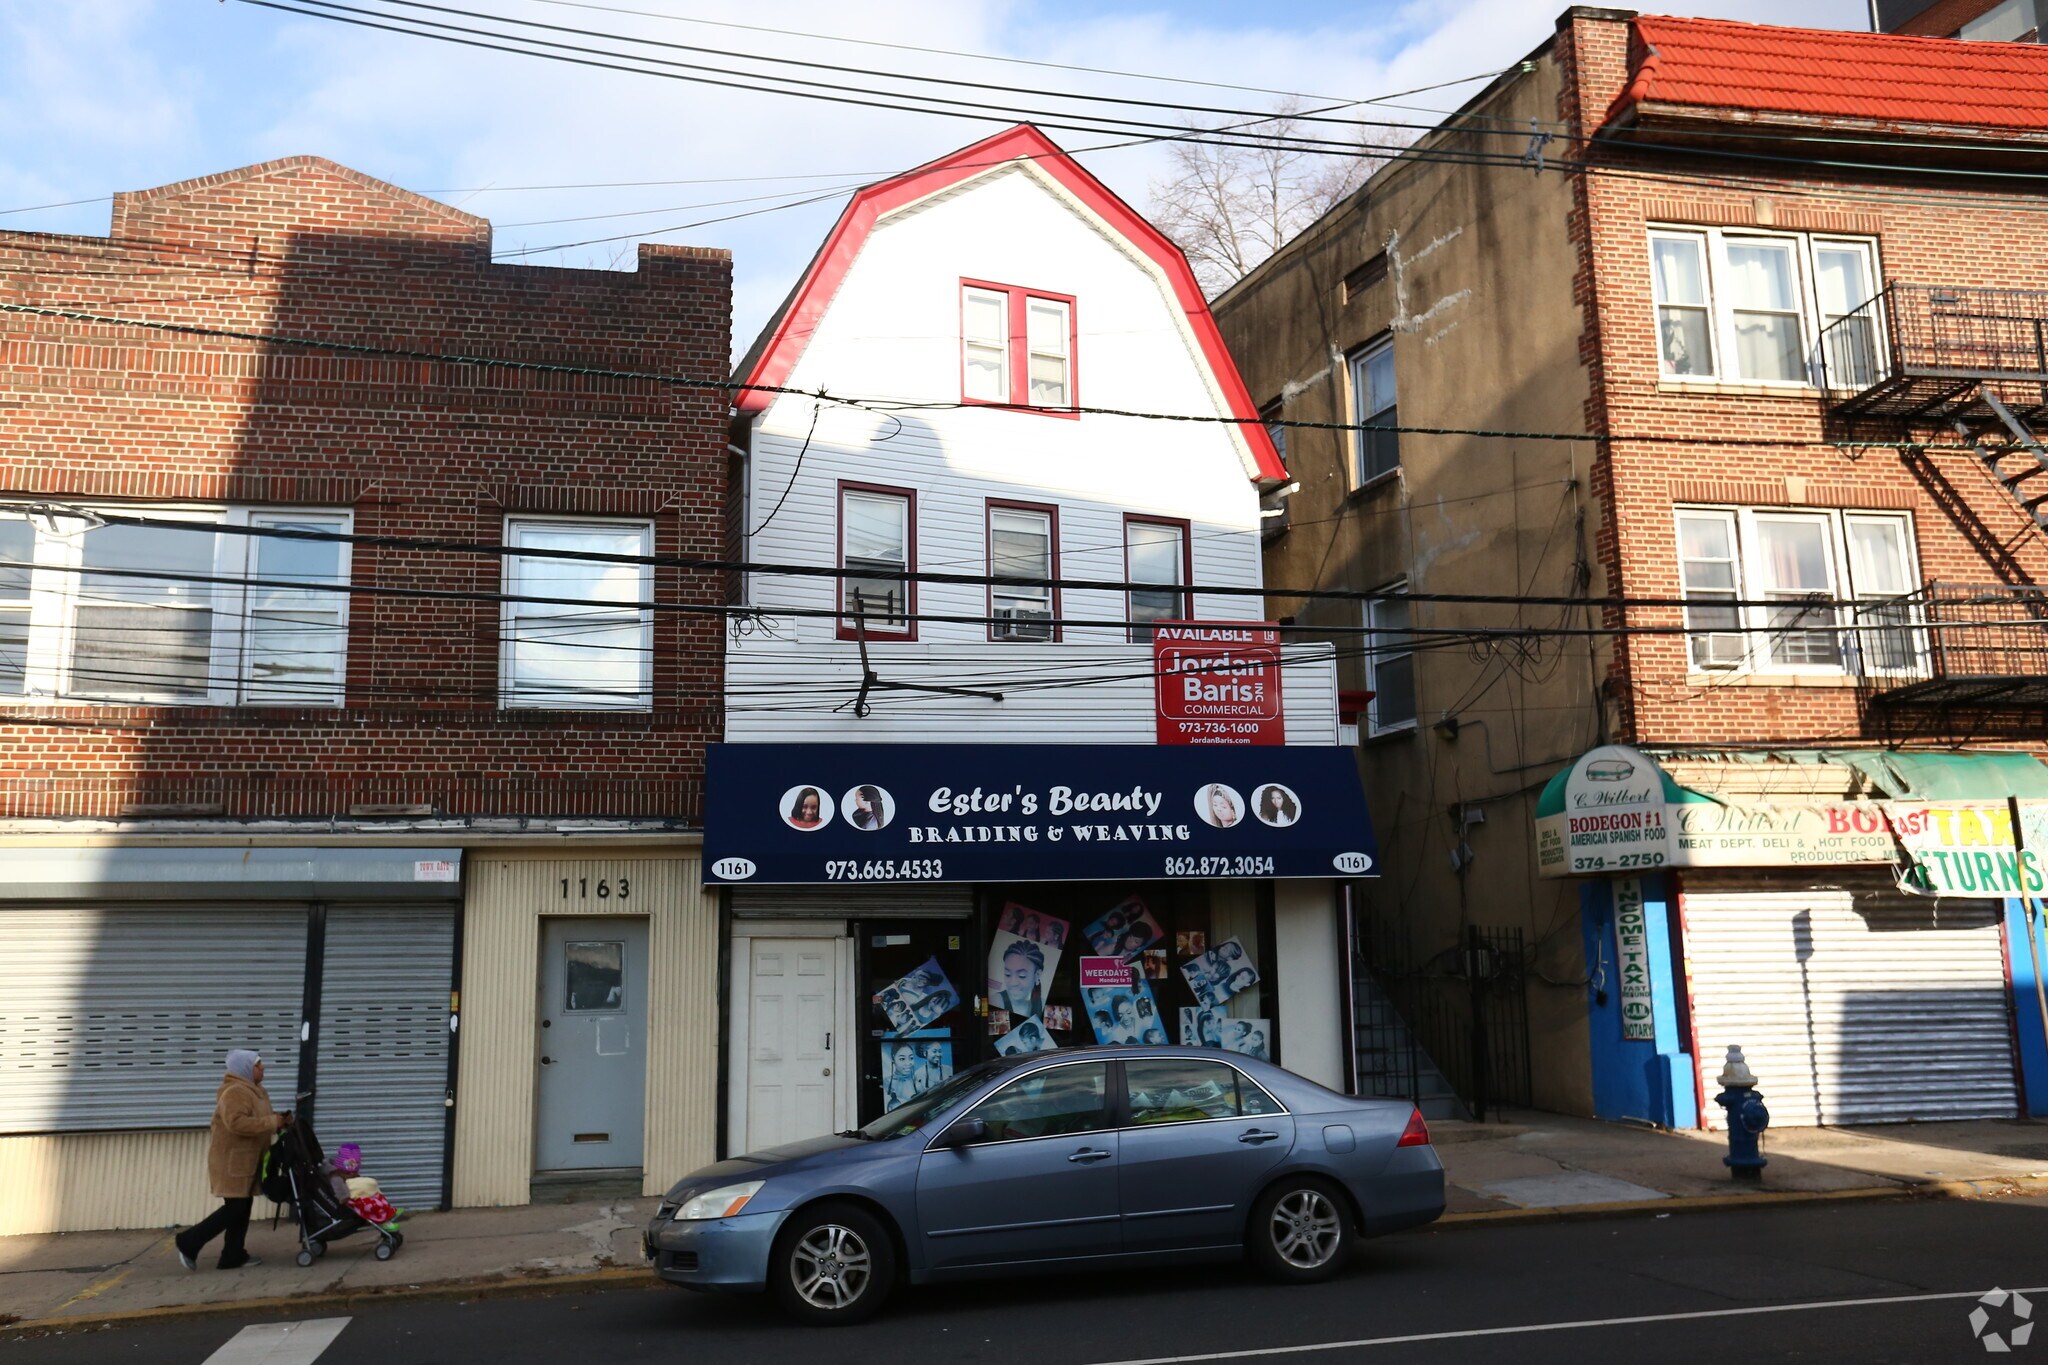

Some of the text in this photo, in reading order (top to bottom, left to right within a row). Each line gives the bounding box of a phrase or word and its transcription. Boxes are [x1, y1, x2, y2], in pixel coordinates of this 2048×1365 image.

[1157, 628, 1253, 642] AVAILABLE
[1166, 652, 1264, 676] Jordan
[1184, 678, 1253, 702] Baris
[1255, 683, 1264, 703] INC
[1185, 705, 1264, 715] COMMERCIAL
[1179, 723, 1259, 733] 973-736-1600
[928, 785, 1162, 816] Ester's Beauty
[1569, 813, 1641, 833] BODEGON
[1654, 812, 1662, 826] 1
[1928, 808, 2017, 846] TAX
[908, 825, 1191, 843] BRAIDING & WEAVING
[1570, 827, 1666, 847] AMERICAN SPANISH FOOD
[1679, 836, 1885, 849] MEAT DEPT. DELI & HOT FOOD
[1165, 856, 1275, 876] 862.872.3054
[1340, 857, 1366, 869] 1161
[1790, 850, 1868, 862] PRODUCTOS
[720, 863, 748, 875] 1161
[825, 859, 943, 880] 973.665.4533
[561, 878, 630, 899] 1163
[1618, 882, 1643, 946] INCOME
[1085, 969, 1129, 977] WEEKDAYS
[1623, 952, 1644, 984] TAX
